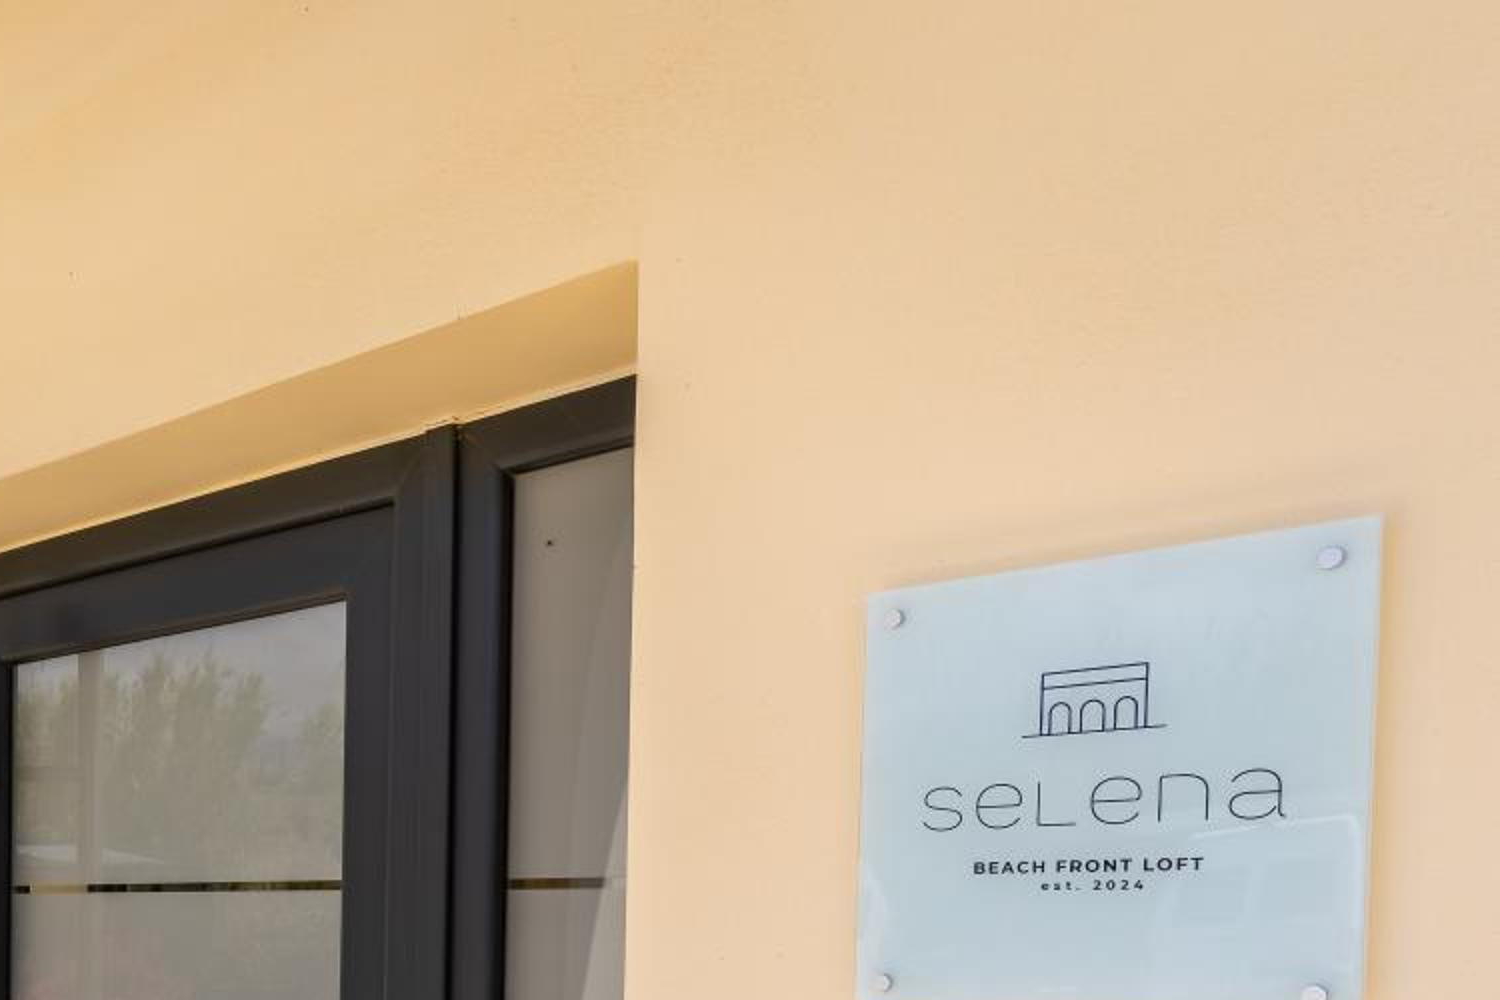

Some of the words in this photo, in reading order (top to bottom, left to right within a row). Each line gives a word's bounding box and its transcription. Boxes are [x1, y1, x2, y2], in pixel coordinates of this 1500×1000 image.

[973, 860, 1046, 875] BEACH
[1055, 858, 1132, 873] FRONT
[1142, 856, 1205, 872] LOFT
[1040, 881, 1082, 891] est.
[1092, 879, 1144, 891] 2024
